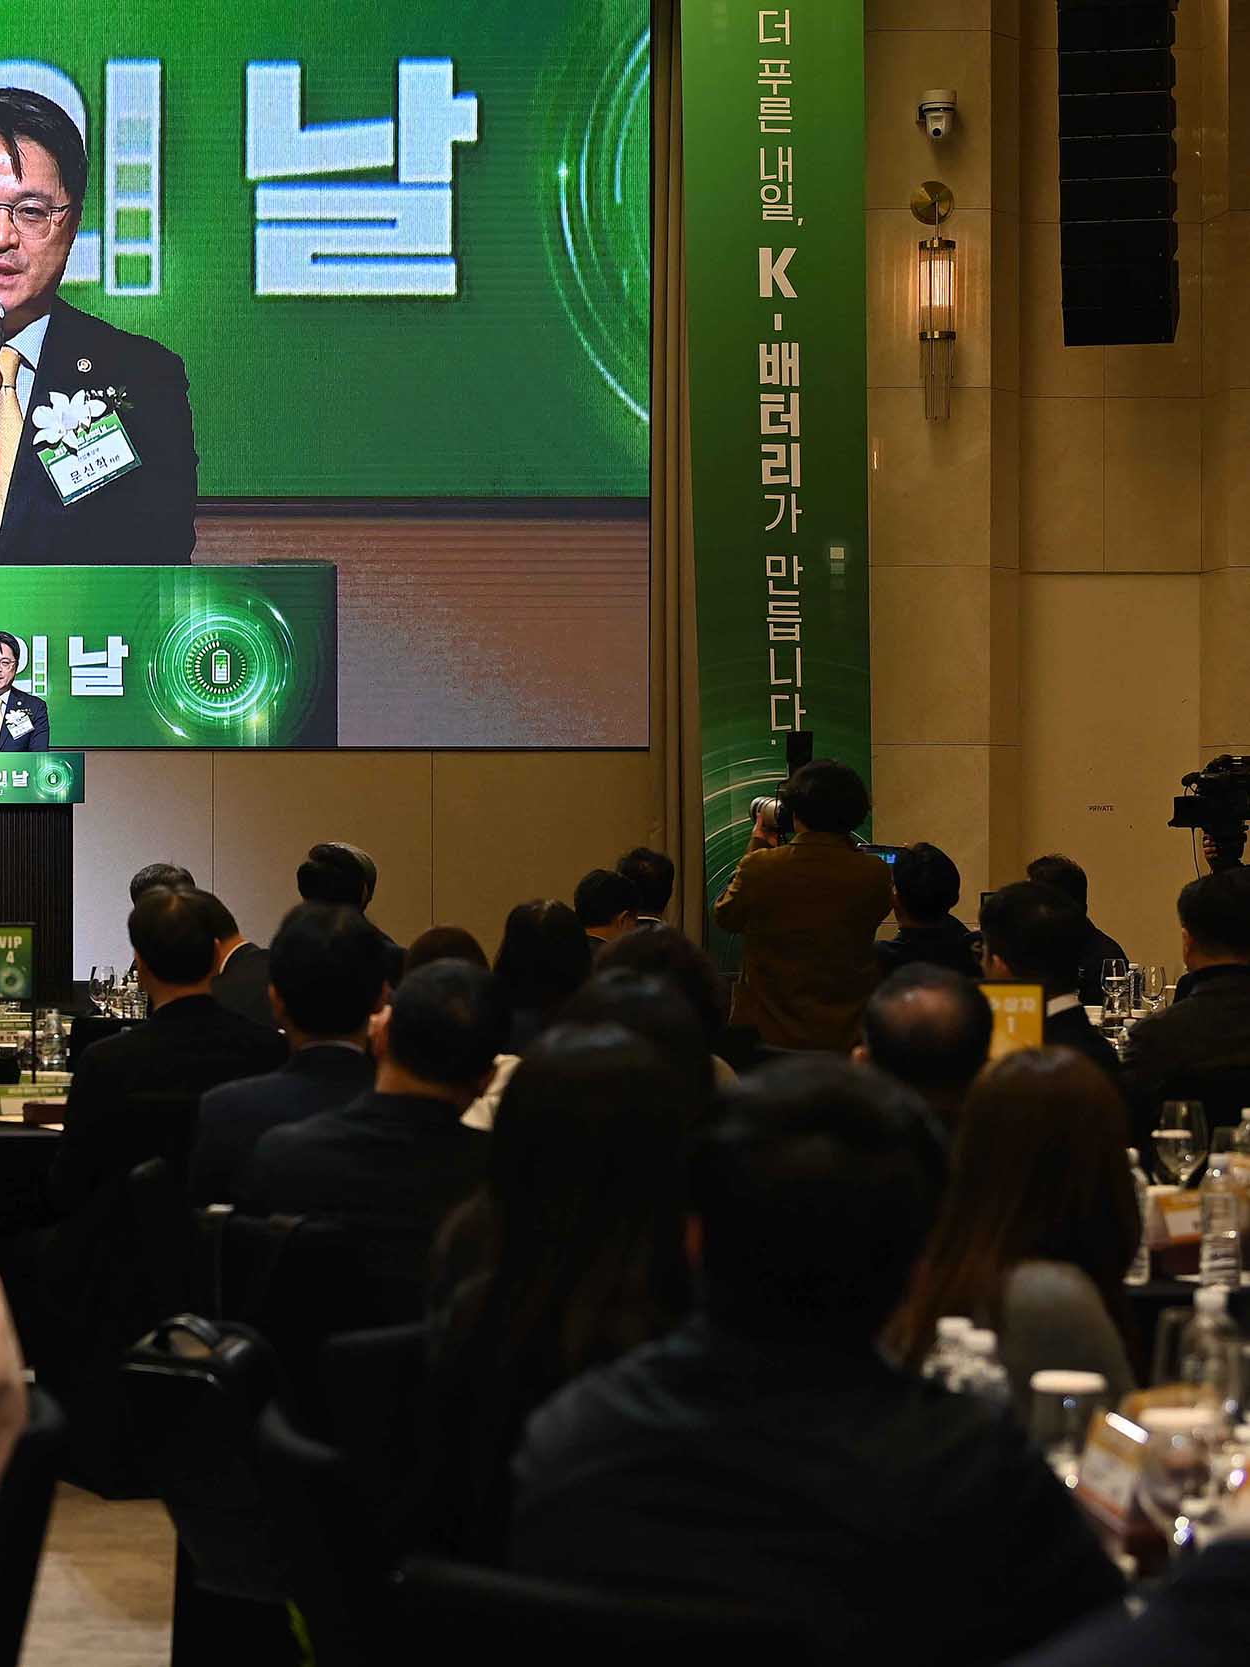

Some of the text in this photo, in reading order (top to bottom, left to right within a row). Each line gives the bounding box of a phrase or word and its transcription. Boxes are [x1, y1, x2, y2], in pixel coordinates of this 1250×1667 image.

[758, 8, 793, 47] 더
[757, 59, 794, 135] 푸른
[245, 56, 480, 297] 날
[759, 146, 805, 228] 내일,
[758, 247, 804, 535] K-배터리가
[68, 635, 130, 698] 날
[12, 770, 29, 787] 날
[6, 951, 15, 963] 4
